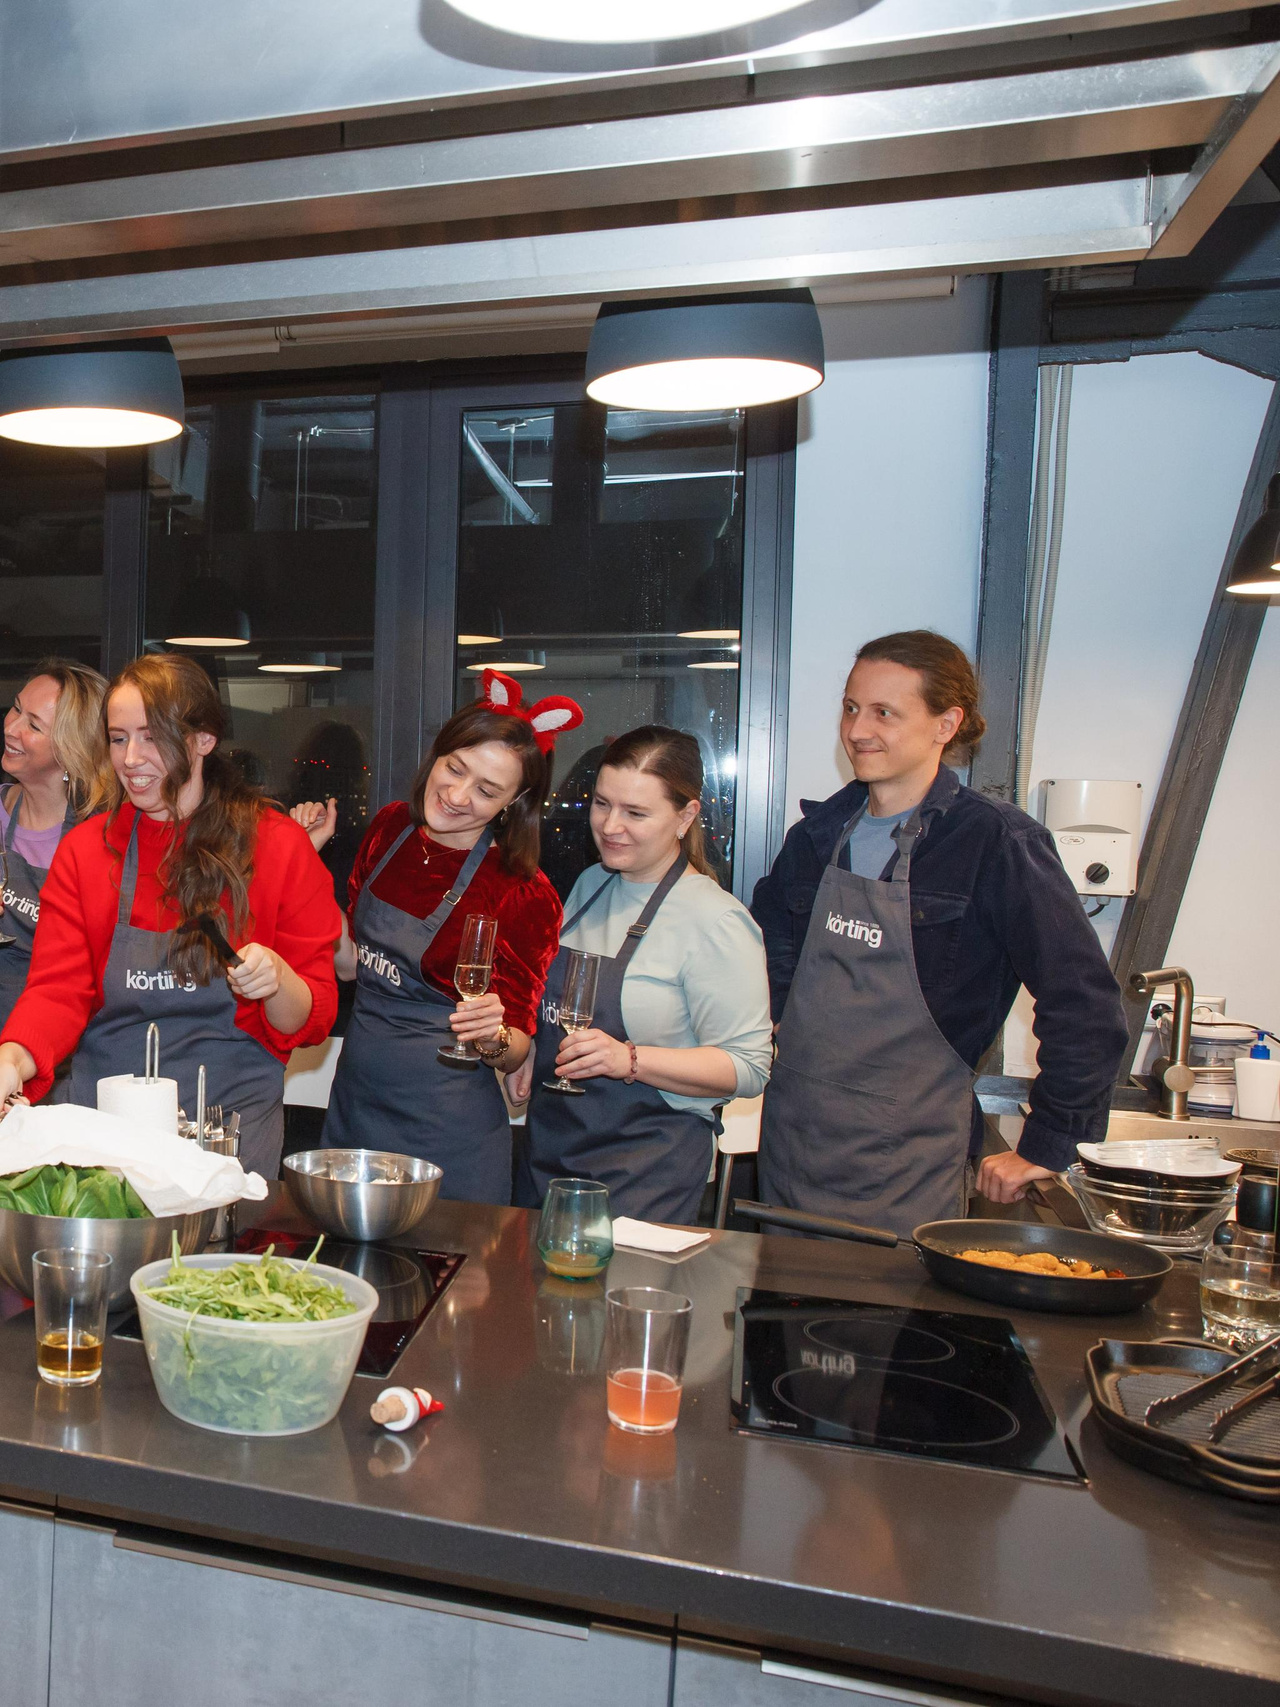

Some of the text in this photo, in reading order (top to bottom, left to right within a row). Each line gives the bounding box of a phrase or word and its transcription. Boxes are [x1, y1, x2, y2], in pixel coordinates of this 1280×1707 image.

[2, 889, 40, 922] örting
[825, 911, 883, 948] körting
[358, 945, 401, 986] örting
